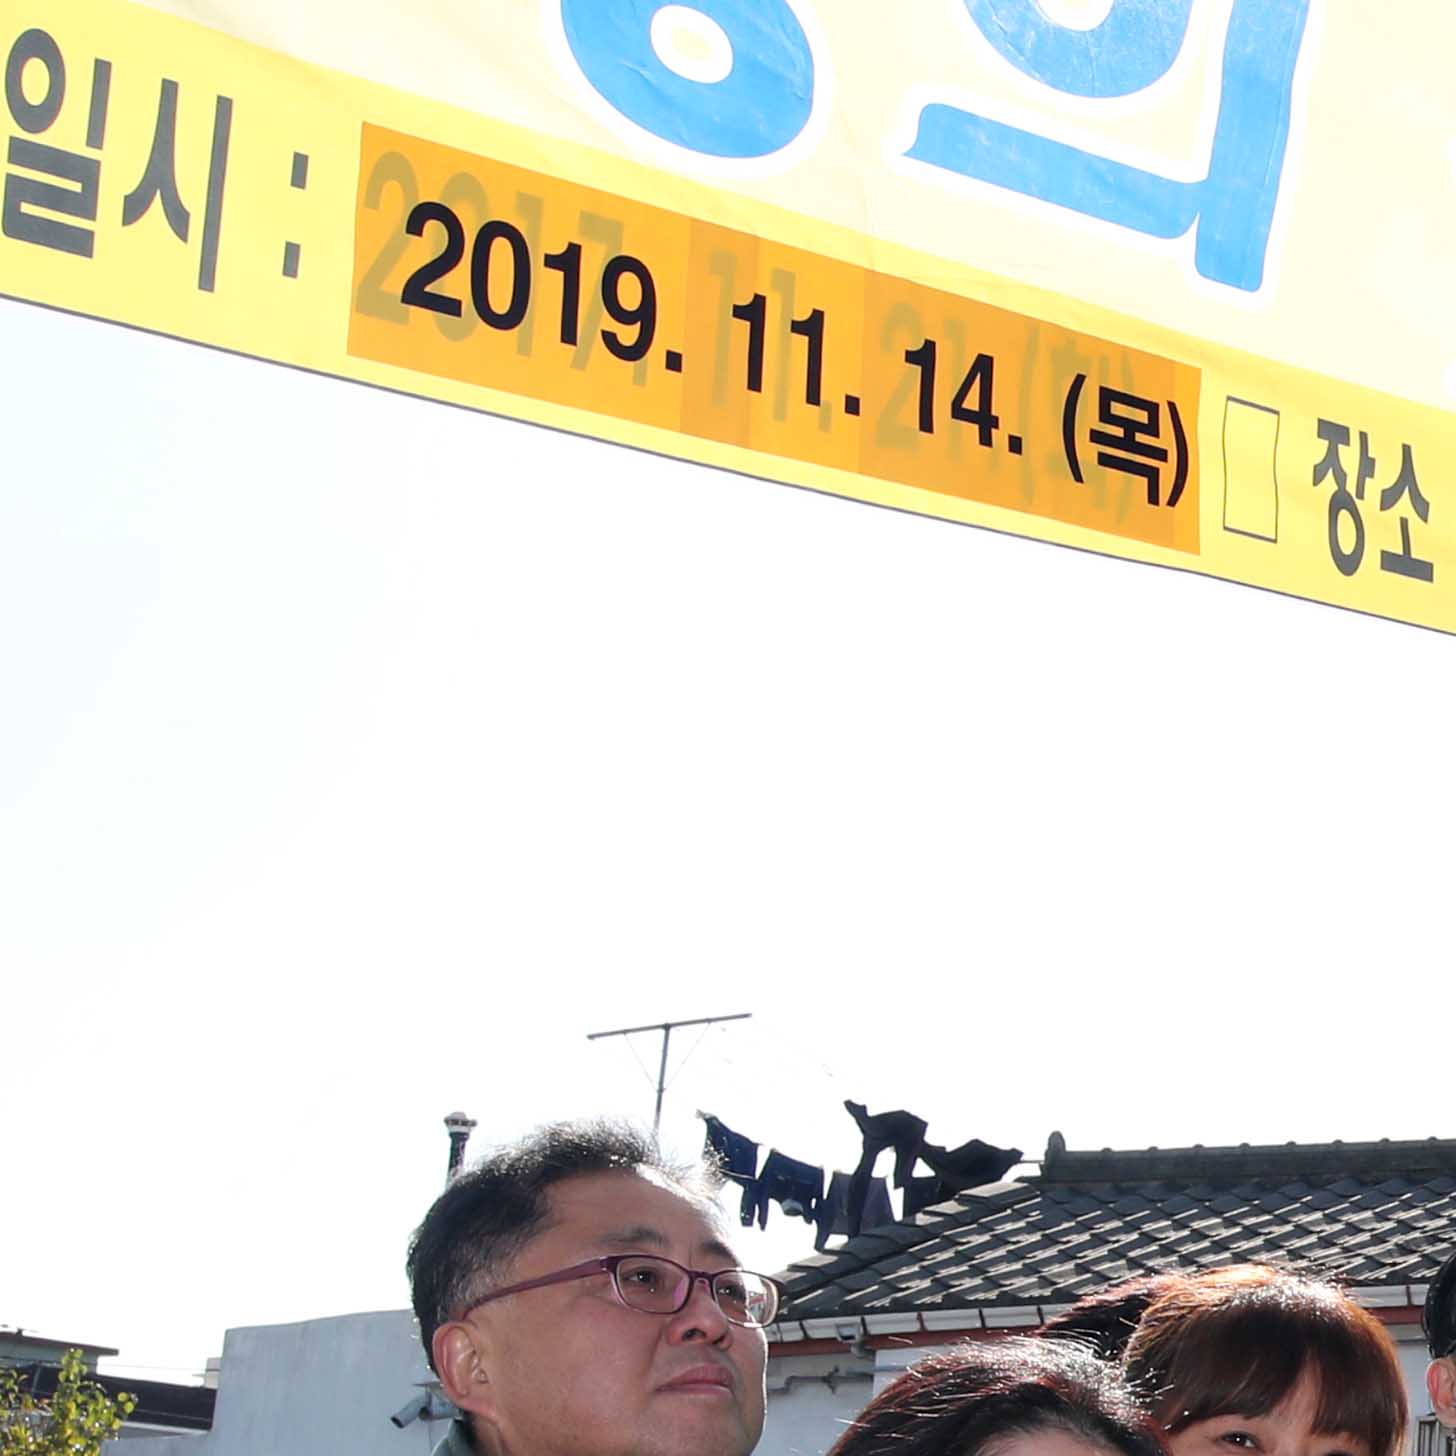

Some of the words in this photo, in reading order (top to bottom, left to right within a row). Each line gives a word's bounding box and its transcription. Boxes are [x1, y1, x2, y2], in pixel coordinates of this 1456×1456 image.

[2, 28, 233, 292] 일시
[400, 201, 684, 373] 2019.
[731, 292, 861, 417] 11.
[905, 339, 1024, 456] 14.
[1062, 374, 1190, 507] (목)
[1313, 418, 1434, 583] 장소
